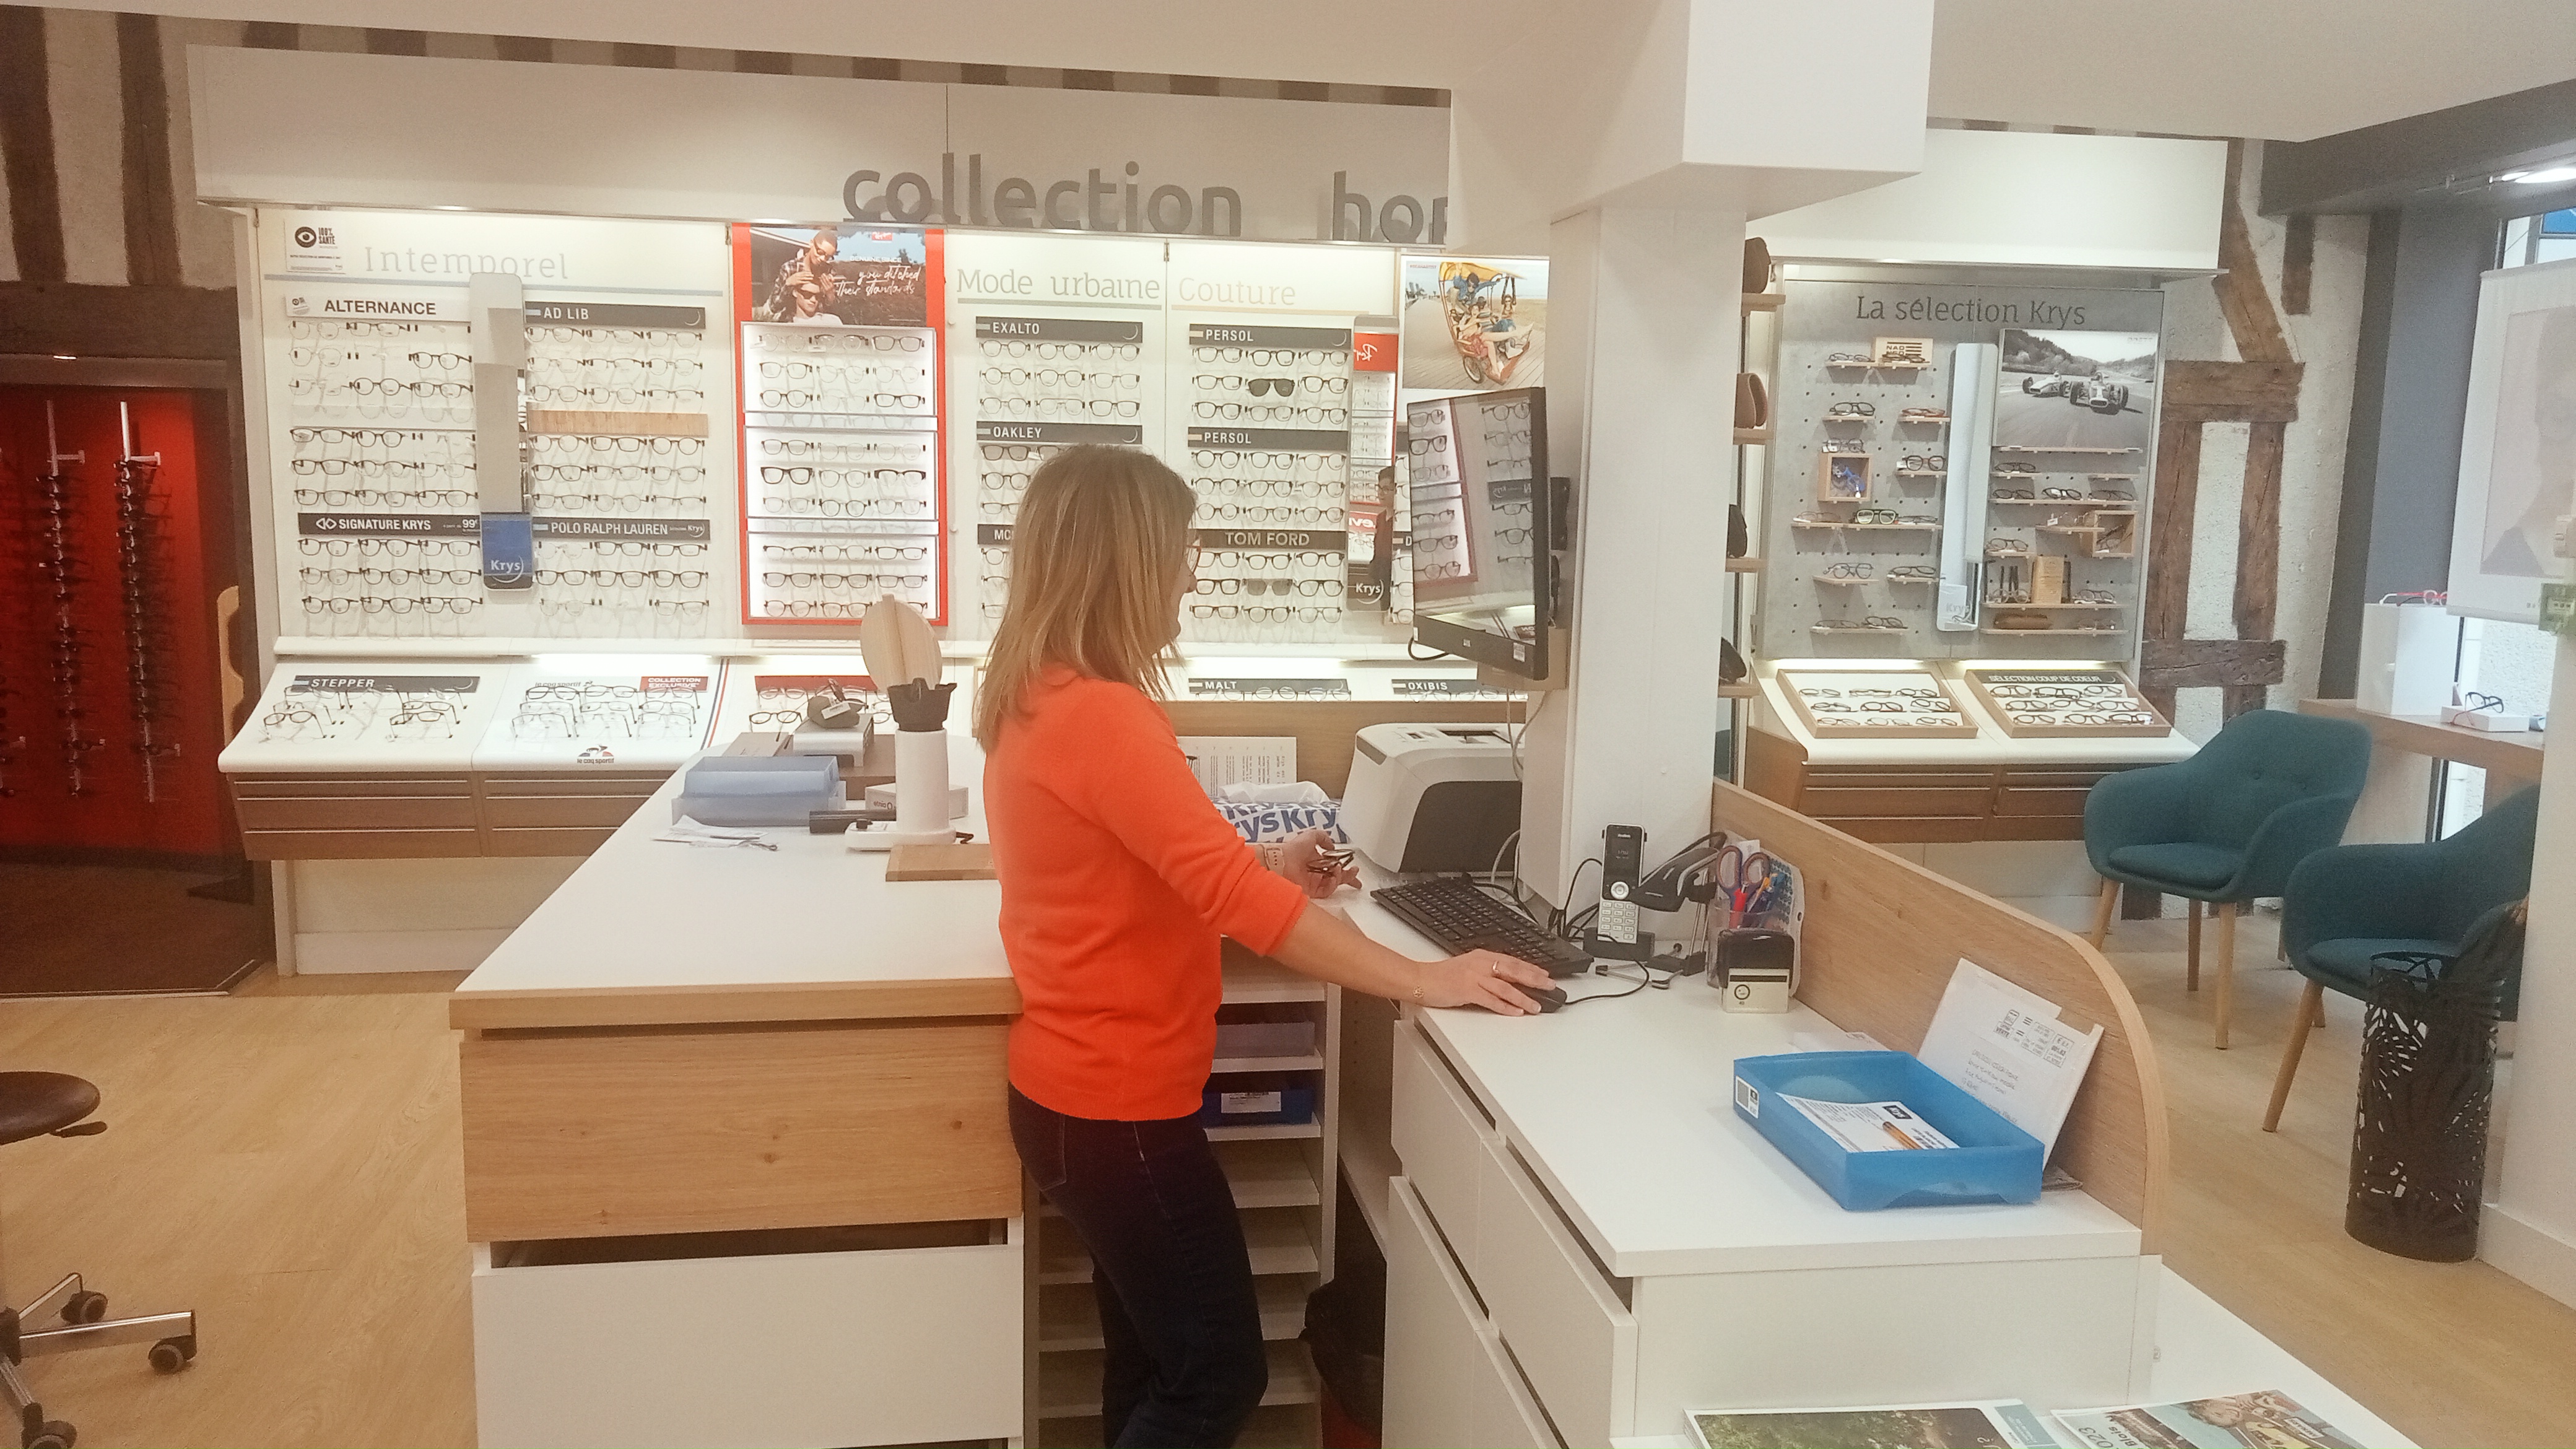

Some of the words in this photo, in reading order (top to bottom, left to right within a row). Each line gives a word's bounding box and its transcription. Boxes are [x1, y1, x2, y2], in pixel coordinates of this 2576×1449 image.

[843, 152, 1242, 237] collection
[318, 227, 333, 235] 100%
[365, 246, 568, 279] Intemporel
[957, 269, 1033, 295] Mode
[1051, 272, 1160, 299] urbaine
[1179, 277, 1296, 306] Couture
[324, 300, 437, 315] ALTERNANCE
[544, 307, 562, 319] AD
[567, 308, 589, 320] LIB
[1856, 296, 1884, 320] La
[1895, 296, 2019, 323] sélection
[2029, 300, 2086, 329] Krys
[993, 321, 1040, 336] EXALTO
[1206, 329, 1254, 342] PERSOL
[993, 425, 1042, 439] OAKLEY
[1204, 432, 1251, 444] PERSOL
[339, 520, 400, 529] SIGNATURE
[402, 520, 431, 530] KRYS
[551, 523, 580, 533] POLO
[584, 523, 620, 534] RALPH
[624, 524, 668, 535] LAUREN
[1225, 532, 1261, 546] TOM
[1266, 533, 1310, 546] FORD
[491, 560, 521, 573] Krys
[1355, 583, 1381, 596] Krys
[311, 679, 375, 687] STEPPER
[1205, 681, 1237, 689] MALT
[1408, 682, 1448, 690] OXIBIS
[1281, 808, 1337, 833] Kry
[2078, 1426, 2118, 1449] 023
[2108, 1426, 2136, 1447] Blois
